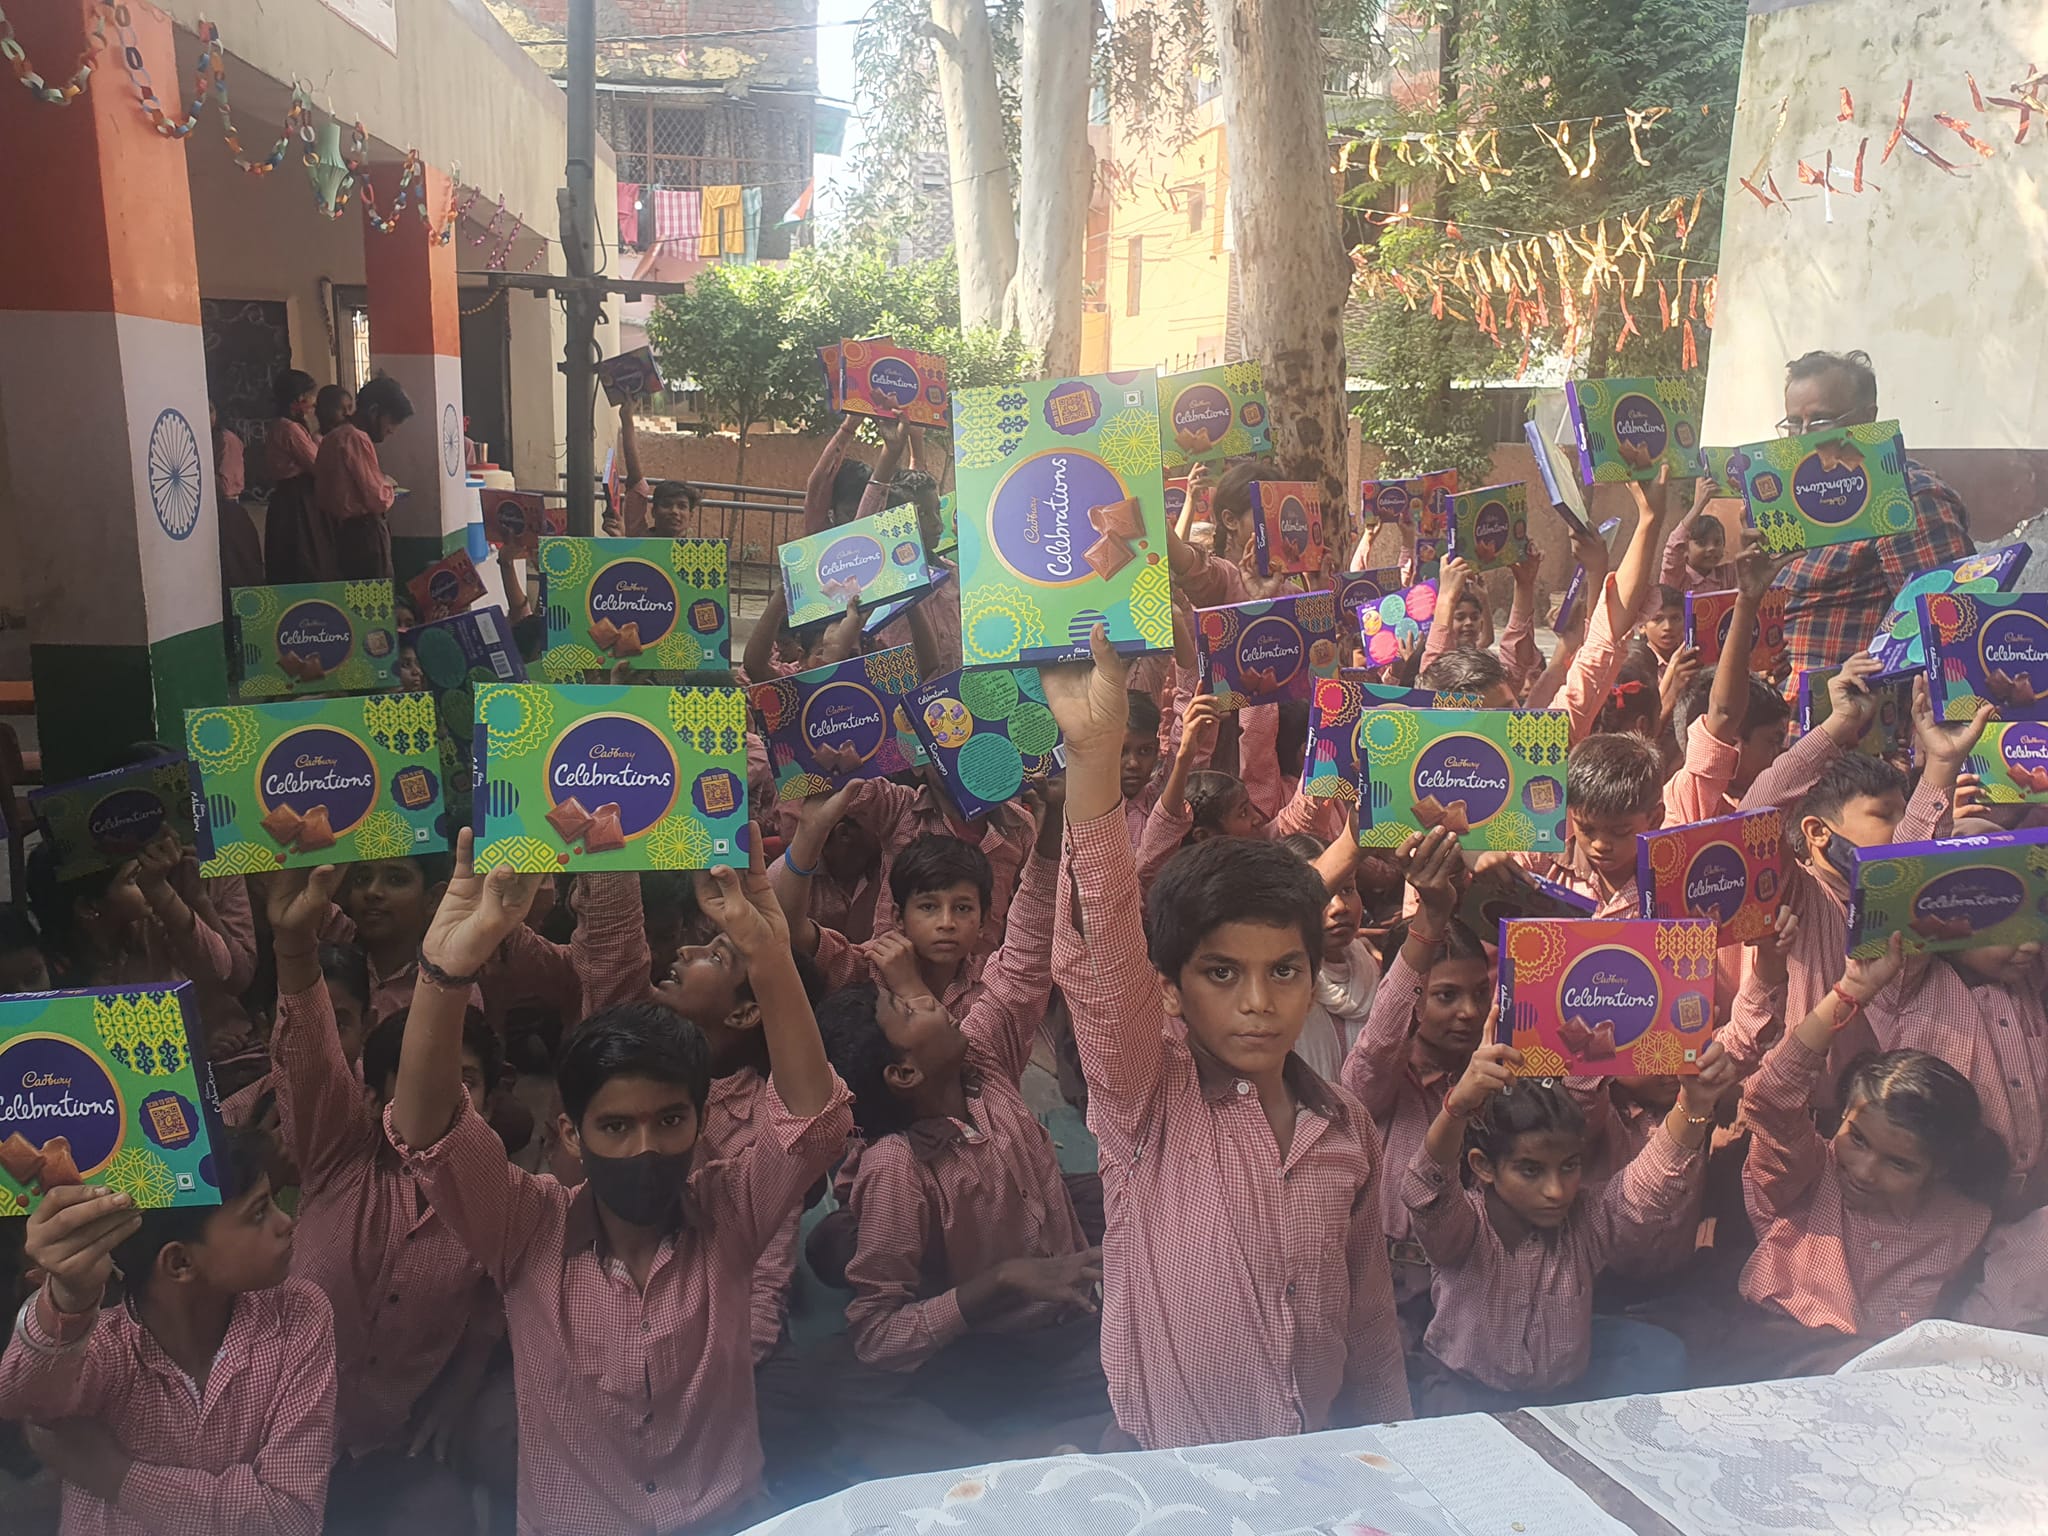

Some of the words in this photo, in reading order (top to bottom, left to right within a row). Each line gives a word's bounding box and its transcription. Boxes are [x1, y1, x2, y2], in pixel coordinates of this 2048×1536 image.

[871, 374, 918, 390] Celebrations
[1175, 407, 1229, 424] Celebrations
[1616, 419, 1665, 434] Celebrations
[1795, 475, 1864, 497] Celebrations
[1024, 495, 1038, 545] Cadbury
[1046, 457, 1069, 577] Celebrations
[821, 552, 881, 577] Celebrations
[615, 580, 649, 593] Cadbury
[593, 593, 674, 614] Celebrations
[280, 629, 350, 645] Celebrations
[1240, 645, 1300, 663] Celebrations
[918, 687, 949, 705] Celebrations
[809, 711, 880, 738] Celebrations
[589, 744, 635, 760] Cadbury
[295, 754, 337, 769] Cadbury
[1444, 756, 1480, 769] Cadbury
[265, 770, 372, 795] Celebrations
[554, 762, 671, 787] Celebrations
[1418, 770, 1506, 790] Celebrations
[1688, 875, 1744, 898] Celebrations
[1918, 895, 2021, 909] Celebrations
[1592, 972, 1628, 985] Cadbury
[1565, 986, 1655, 1007] Celebrations
[22, 1070, 71, 1088] Cadbury
